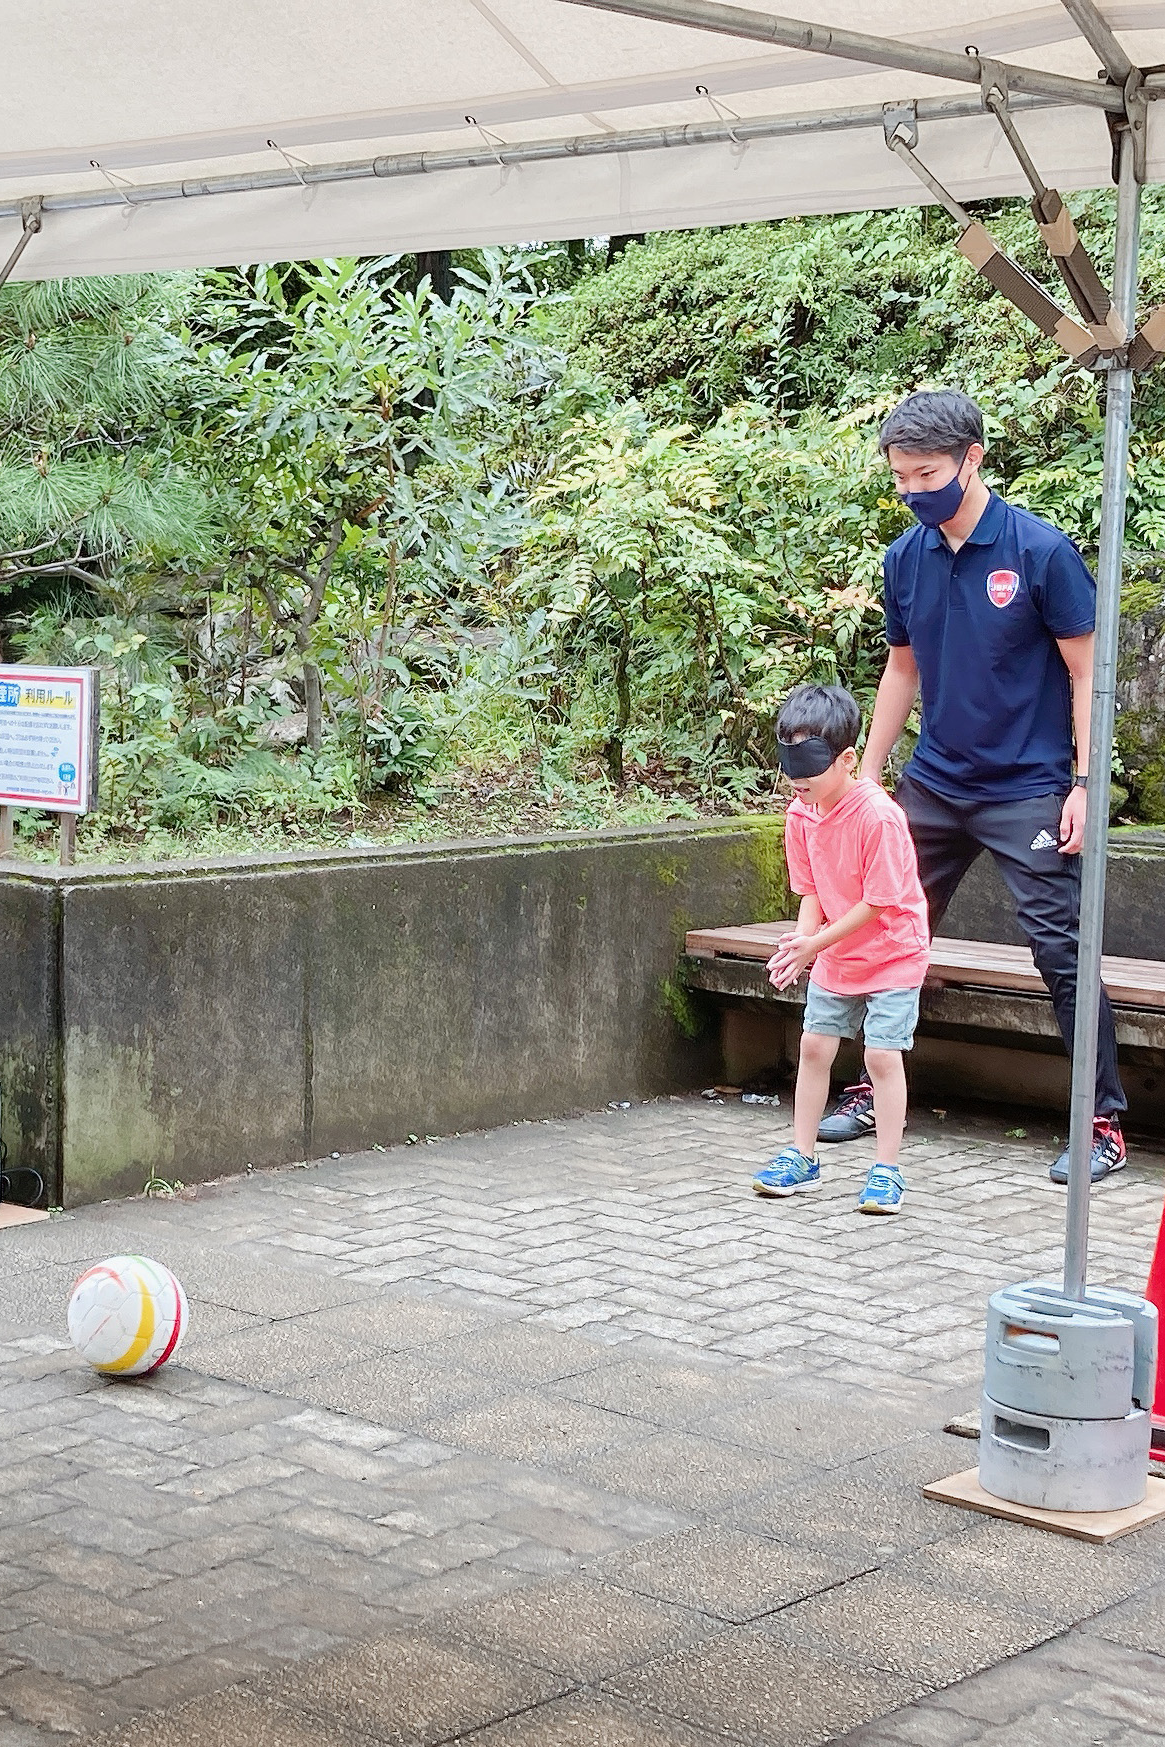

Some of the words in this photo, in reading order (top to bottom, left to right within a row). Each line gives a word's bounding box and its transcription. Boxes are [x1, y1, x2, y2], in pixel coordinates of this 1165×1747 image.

[25, 687, 74, 706] 利用ルール
